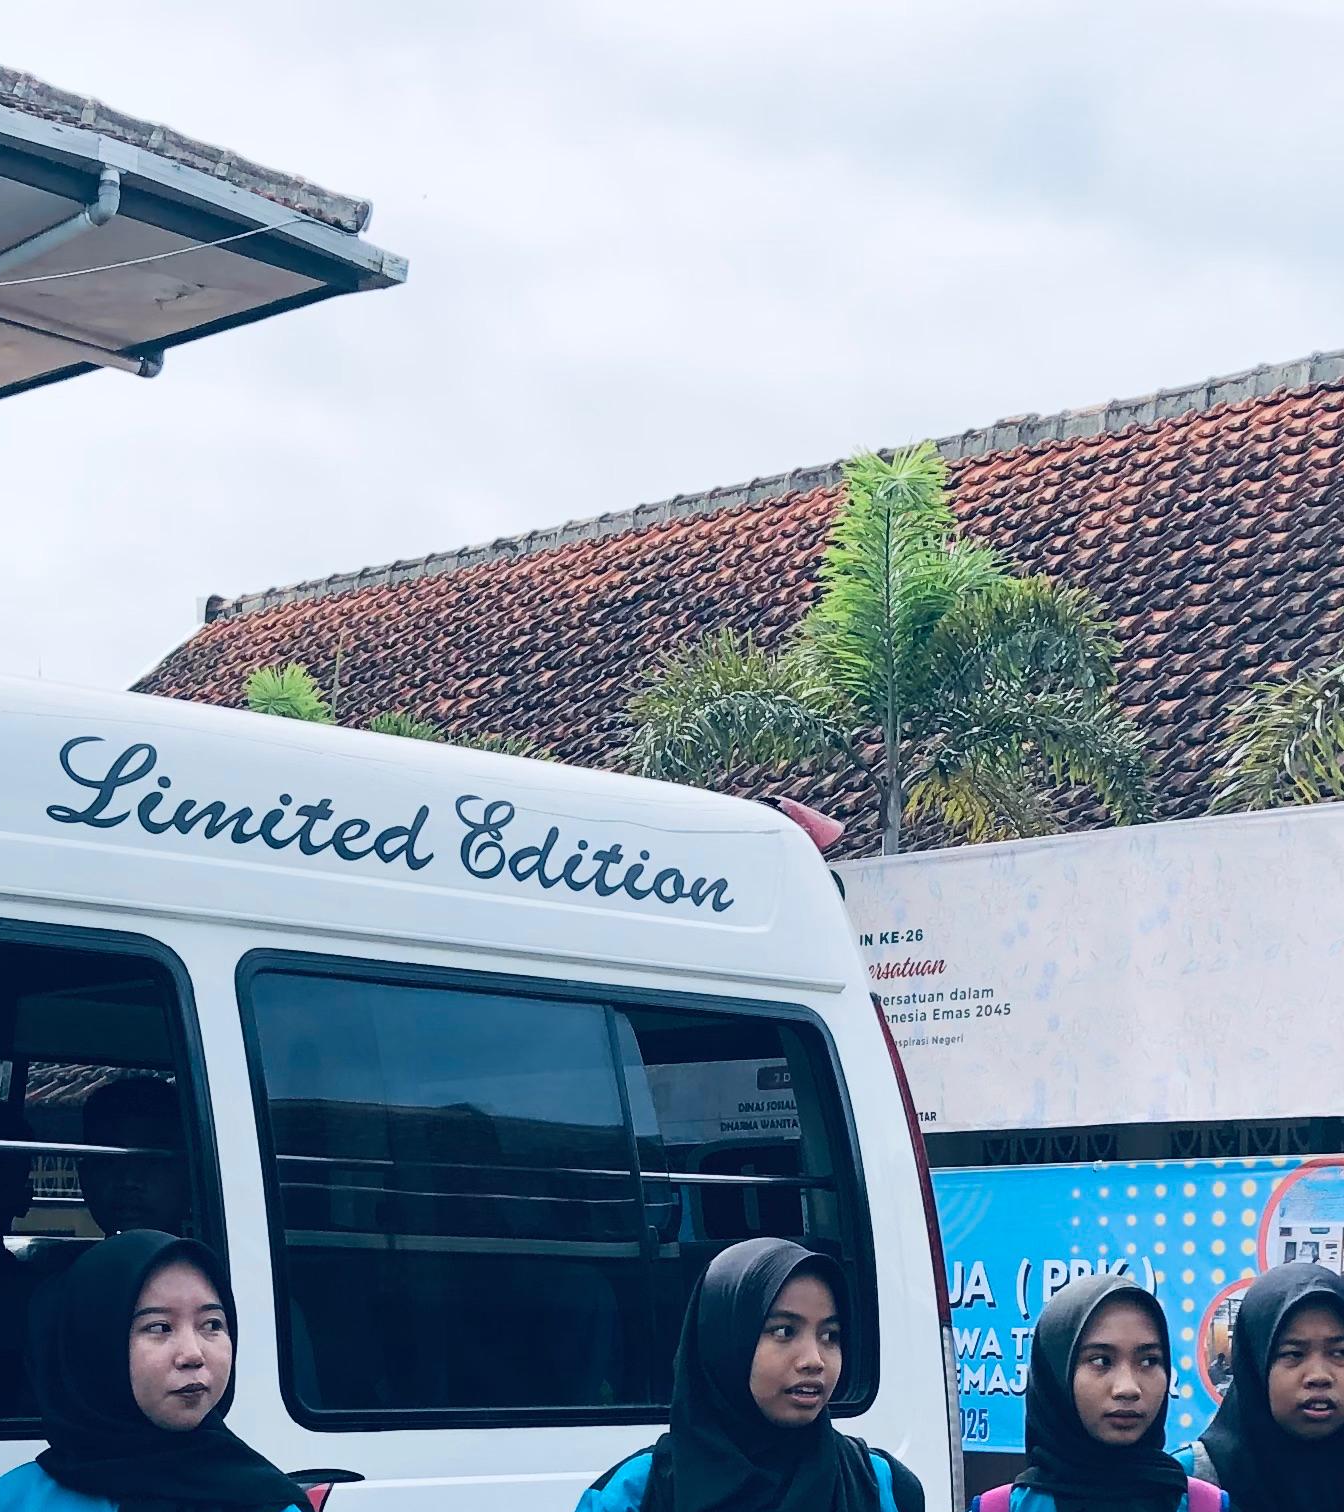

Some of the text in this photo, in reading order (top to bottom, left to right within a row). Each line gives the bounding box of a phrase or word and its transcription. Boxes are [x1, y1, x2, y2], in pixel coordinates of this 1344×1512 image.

[46, 736, 735, 912] Limited Edition
[868, 957, 947, 980] ersatuan
[950, 987, 994, 1001] dalam
[932, 1007, 970, 1021] Emas
[975, 1003, 1011, 1018] 2045
[932, 1033, 964, 1046] Negeri
[738, 1100, 797, 1113] DINAS SOSIAL
[720, 1119, 799, 1132] DHARMA WANITA
